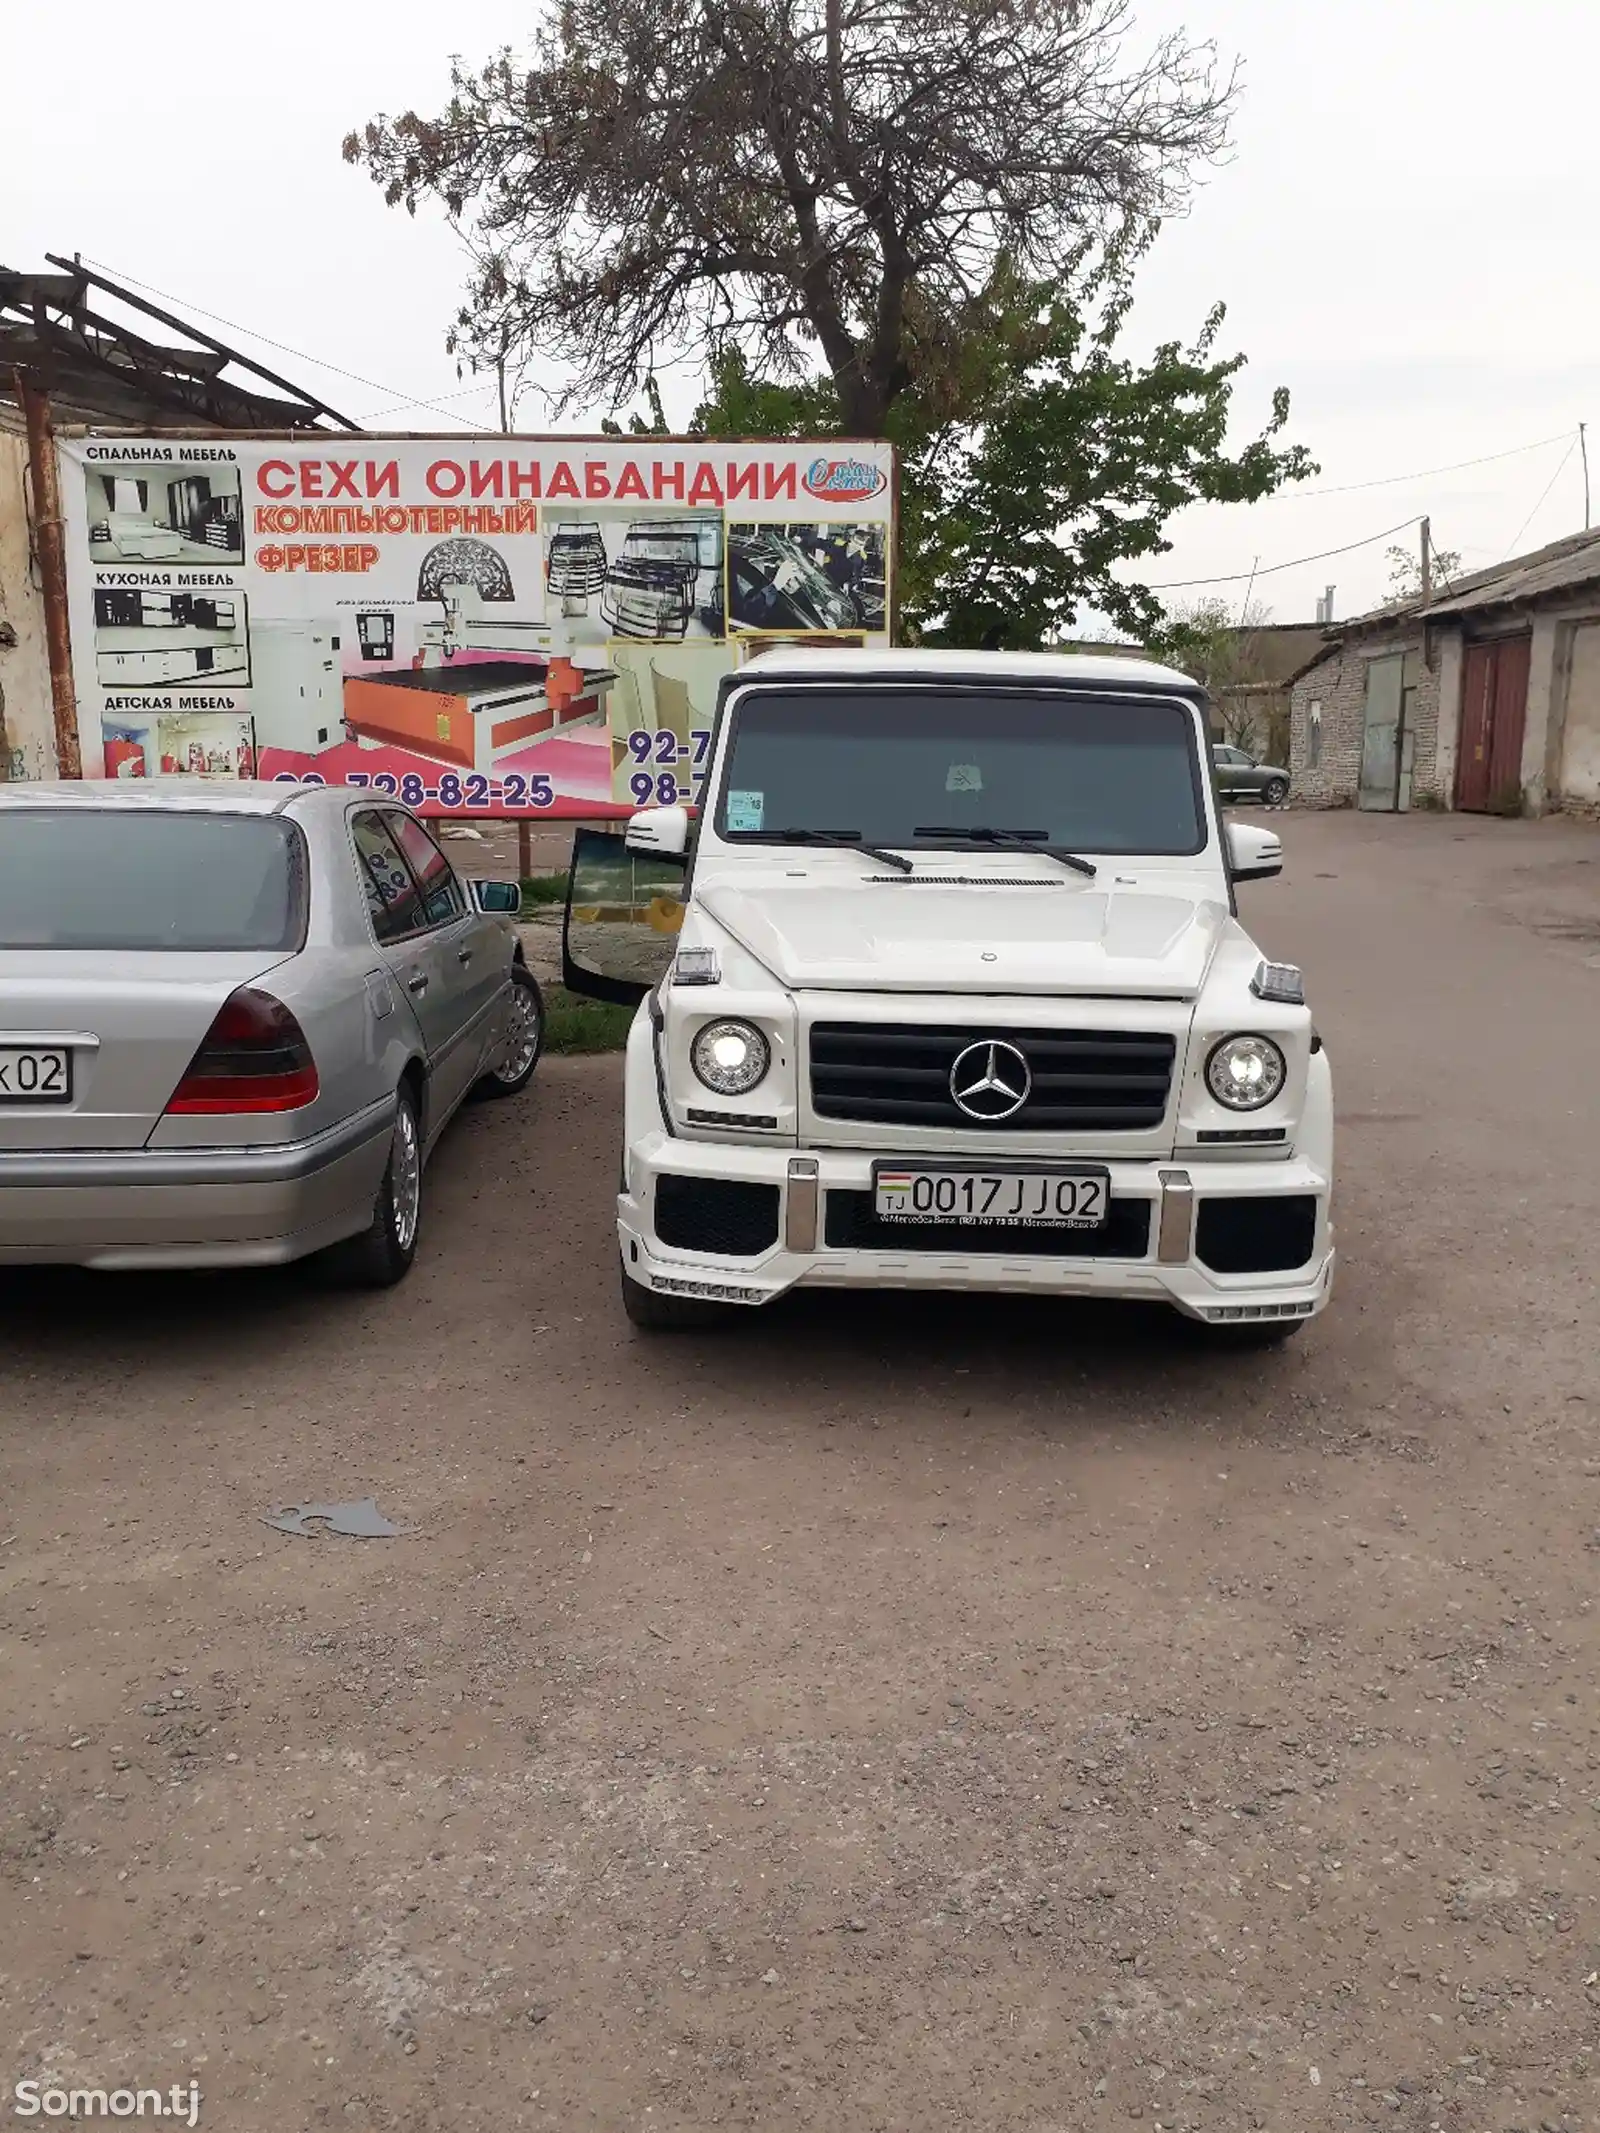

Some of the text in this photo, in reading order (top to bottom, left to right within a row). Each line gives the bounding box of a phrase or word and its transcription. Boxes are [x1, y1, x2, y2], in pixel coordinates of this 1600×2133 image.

[86, 447, 237, 461] СПАЛЬНАЯ МЕБЕЛЬ
[256, 460, 400, 499] СЕХИ
[425, 460, 797, 507] ОИНАБАНДИИ
[254, 499, 538, 535] КОМПЬЮТЕРНЫЙ
[254, 543, 380, 573] ФРЕЗЕР
[96, 573, 234, 586] КУХОНАЯ МЕБЕЛЬ
[104, 697, 235, 710] ДЕТСКАЯ МЕБЕЛЬ
[885, 1196, 905, 1210] TJ
